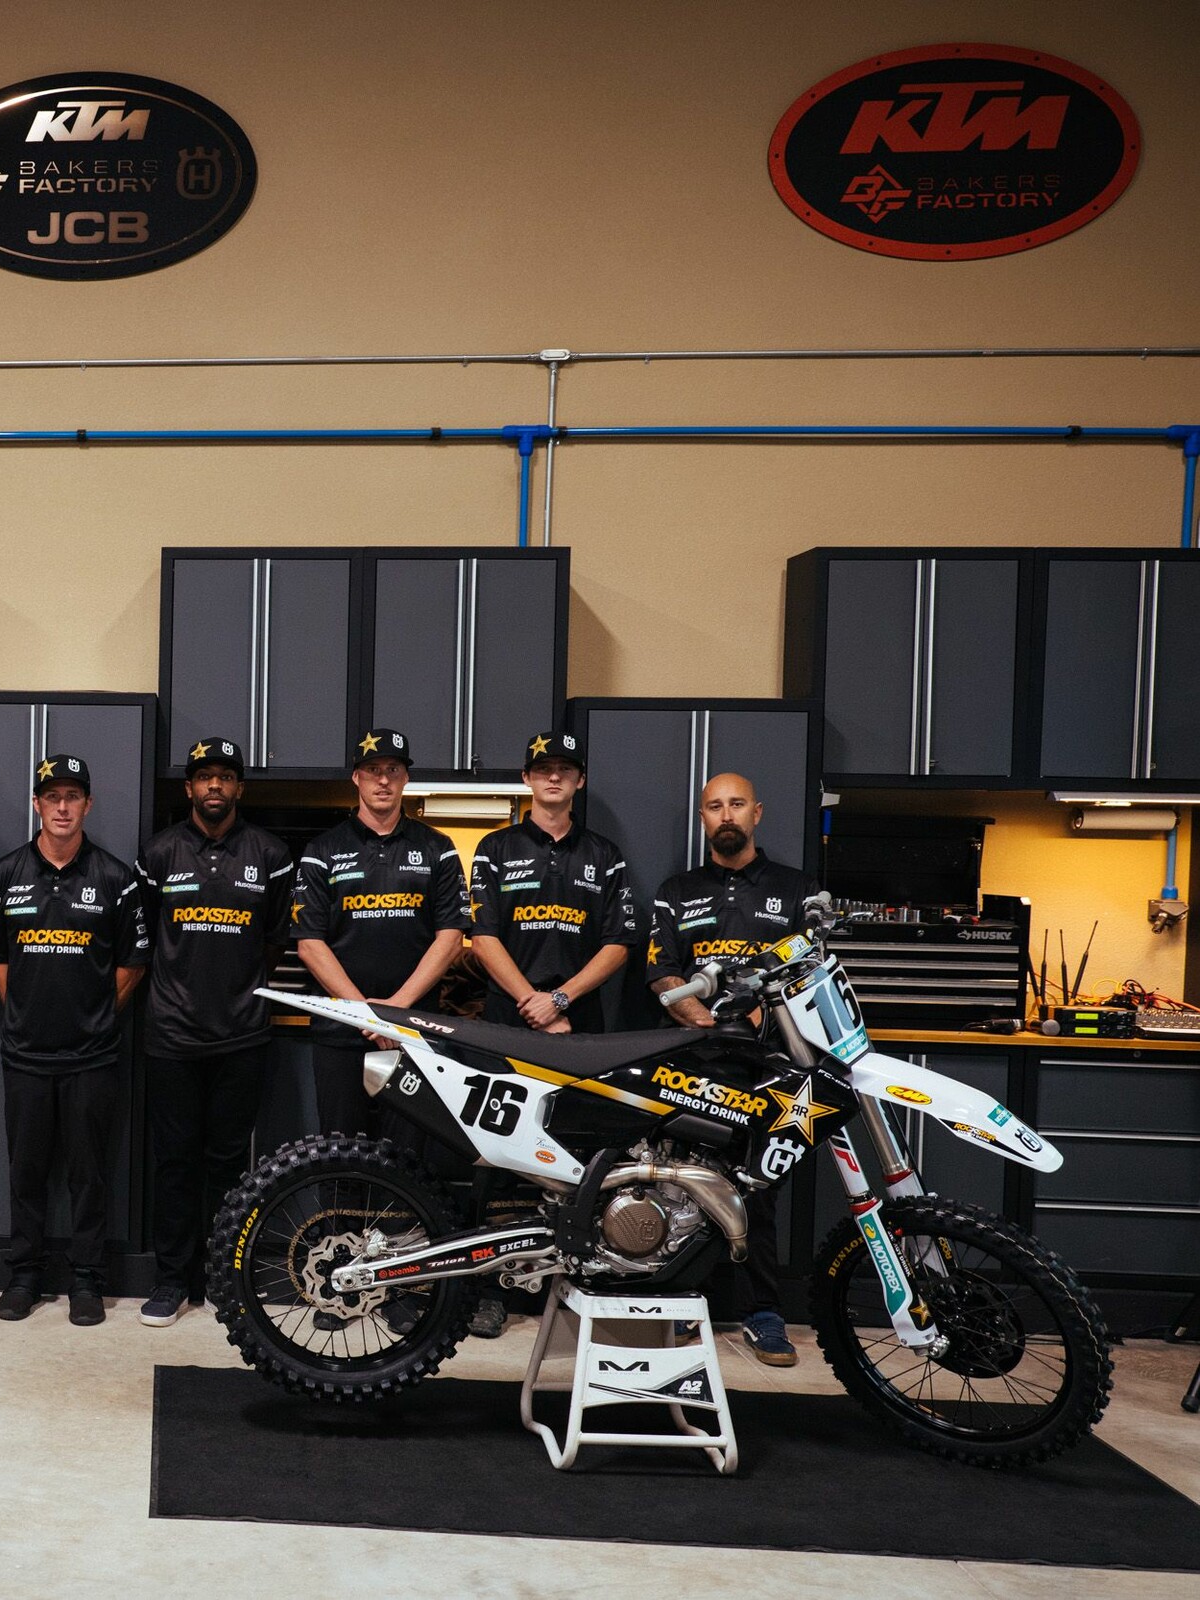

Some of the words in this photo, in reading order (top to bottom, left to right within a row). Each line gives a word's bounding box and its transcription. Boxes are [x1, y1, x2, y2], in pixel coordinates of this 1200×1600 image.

[25, 101, 150, 142] KTM
[839, 81, 1071, 155] KTM
[18, 178, 158, 194] FACTORY
[916, 192, 1060, 210] FACTORY
[27, 211, 149, 245] JCB
[342, 893, 425, 910] ROCKSTAR
[173, 906, 252, 926] ROCKSTAR
[352, 910, 388, 919] ENERGY
[388, 908, 416, 918] DRINK
[513, 904, 588, 924] ROCKSTAR
[182, 923, 213, 932] ENERGY
[213, 923, 242, 934] DRINK
[520, 921, 556, 931] ENERGY
[972, 931, 1012, 940] HUSKY
[16, 929, 93, 946] ROCKSTAR
[23, 945, 56, 954] ENERGY
[57, 945, 85, 954] DRINK
[804, 970, 862, 1047] 16
[651, 1066, 769, 1117] ROCKSTAR
[459, 1073, 528, 1137] 16
[659, 1088, 708, 1112] ENERGY
[708, 1105, 750, 1126] DRINK
[953, 1122, 997, 1142] ROCKSTAR
[234, 1208, 259, 1271] DUNLOP
[388, 1265, 421, 1277] brembo
[427, 1256, 466, 1268] Talon
[471, 1247, 496, 1261] RK
[499, 1239, 537, 1253] EXCEL
[870, 1240, 903, 1294] MOTOREX
[899, 1254, 911, 1278] DRINK
[680, 1380, 703, 1391] A2
